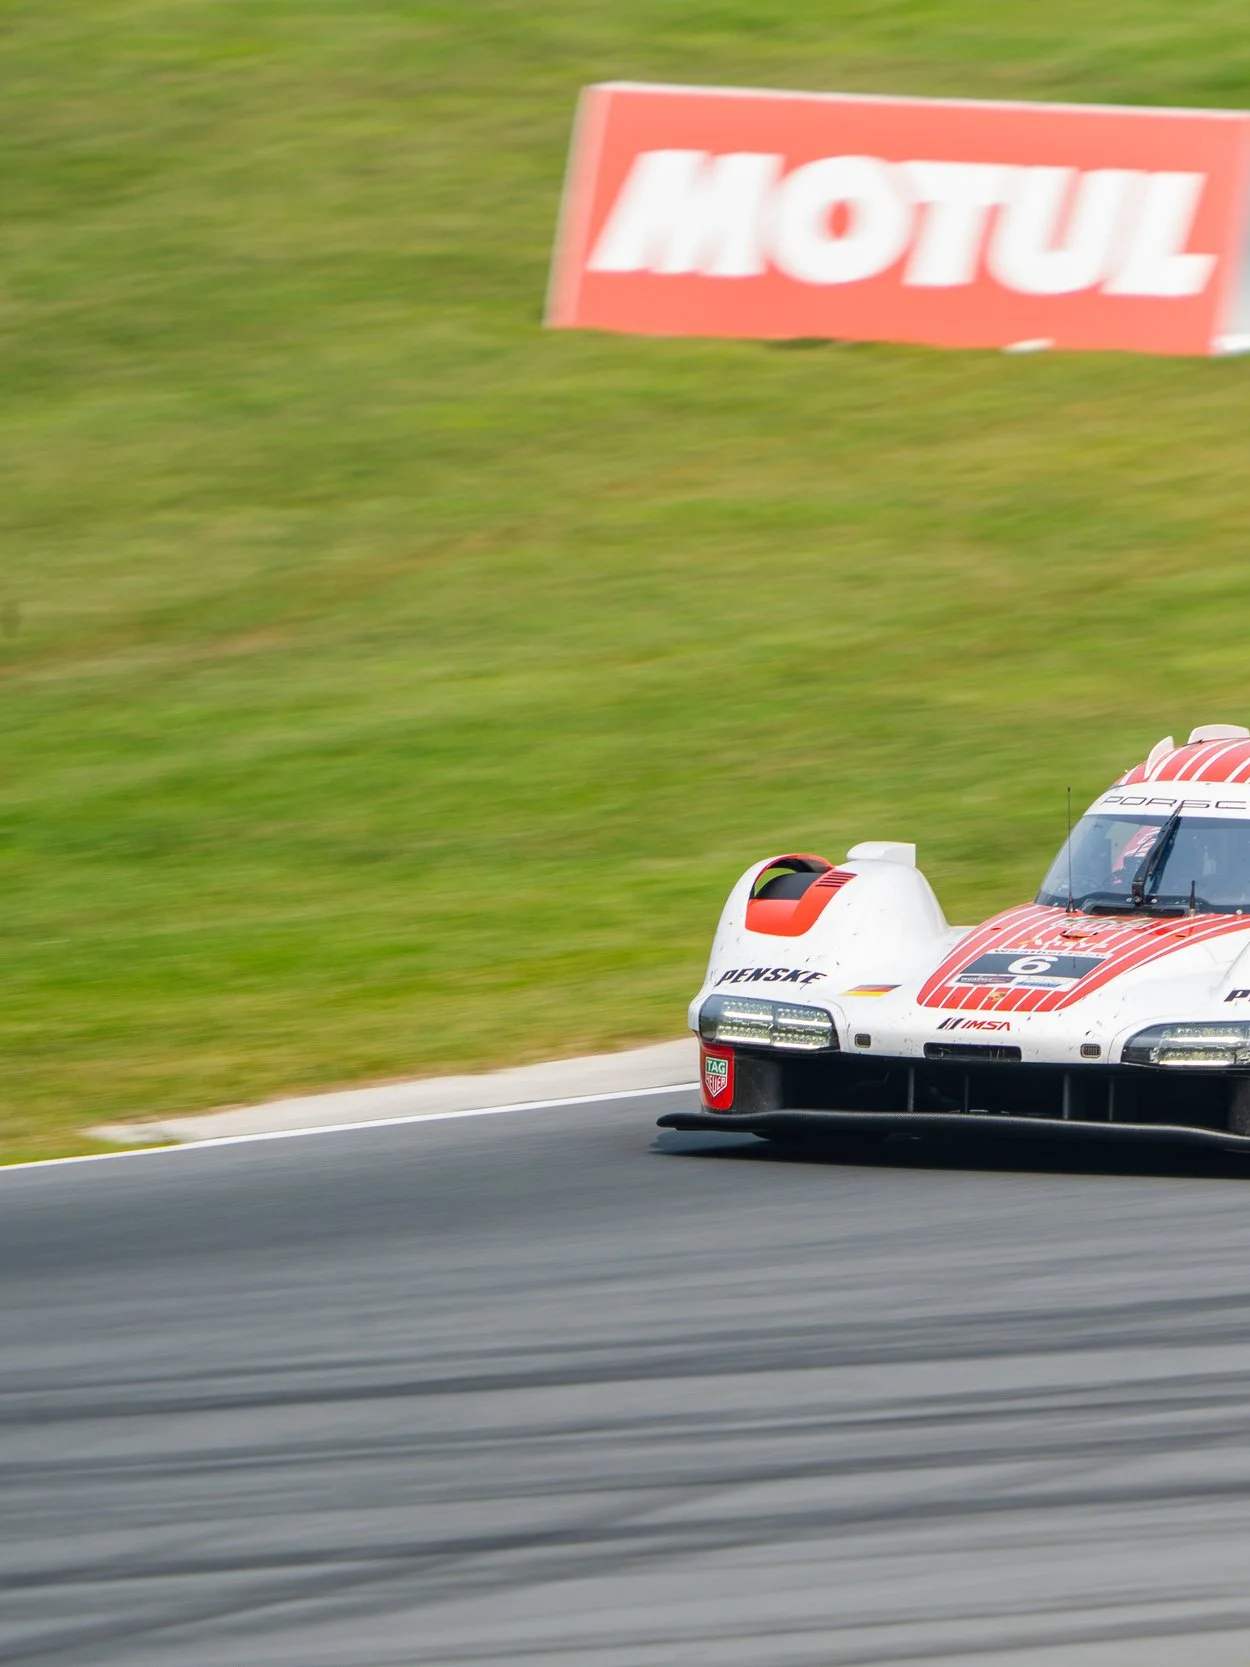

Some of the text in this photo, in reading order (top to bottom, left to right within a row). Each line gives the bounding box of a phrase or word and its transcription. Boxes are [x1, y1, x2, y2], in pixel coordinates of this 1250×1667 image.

[587, 150, 1218, 296] MOTUL
[1008, 956, 1059, 974] 6
[714, 968, 828, 987] PENSKE
[961, 1020, 1010, 1031] IMSA
[707, 1059, 726, 1073] TAG
[706, 1075, 726, 1093] HEUER
